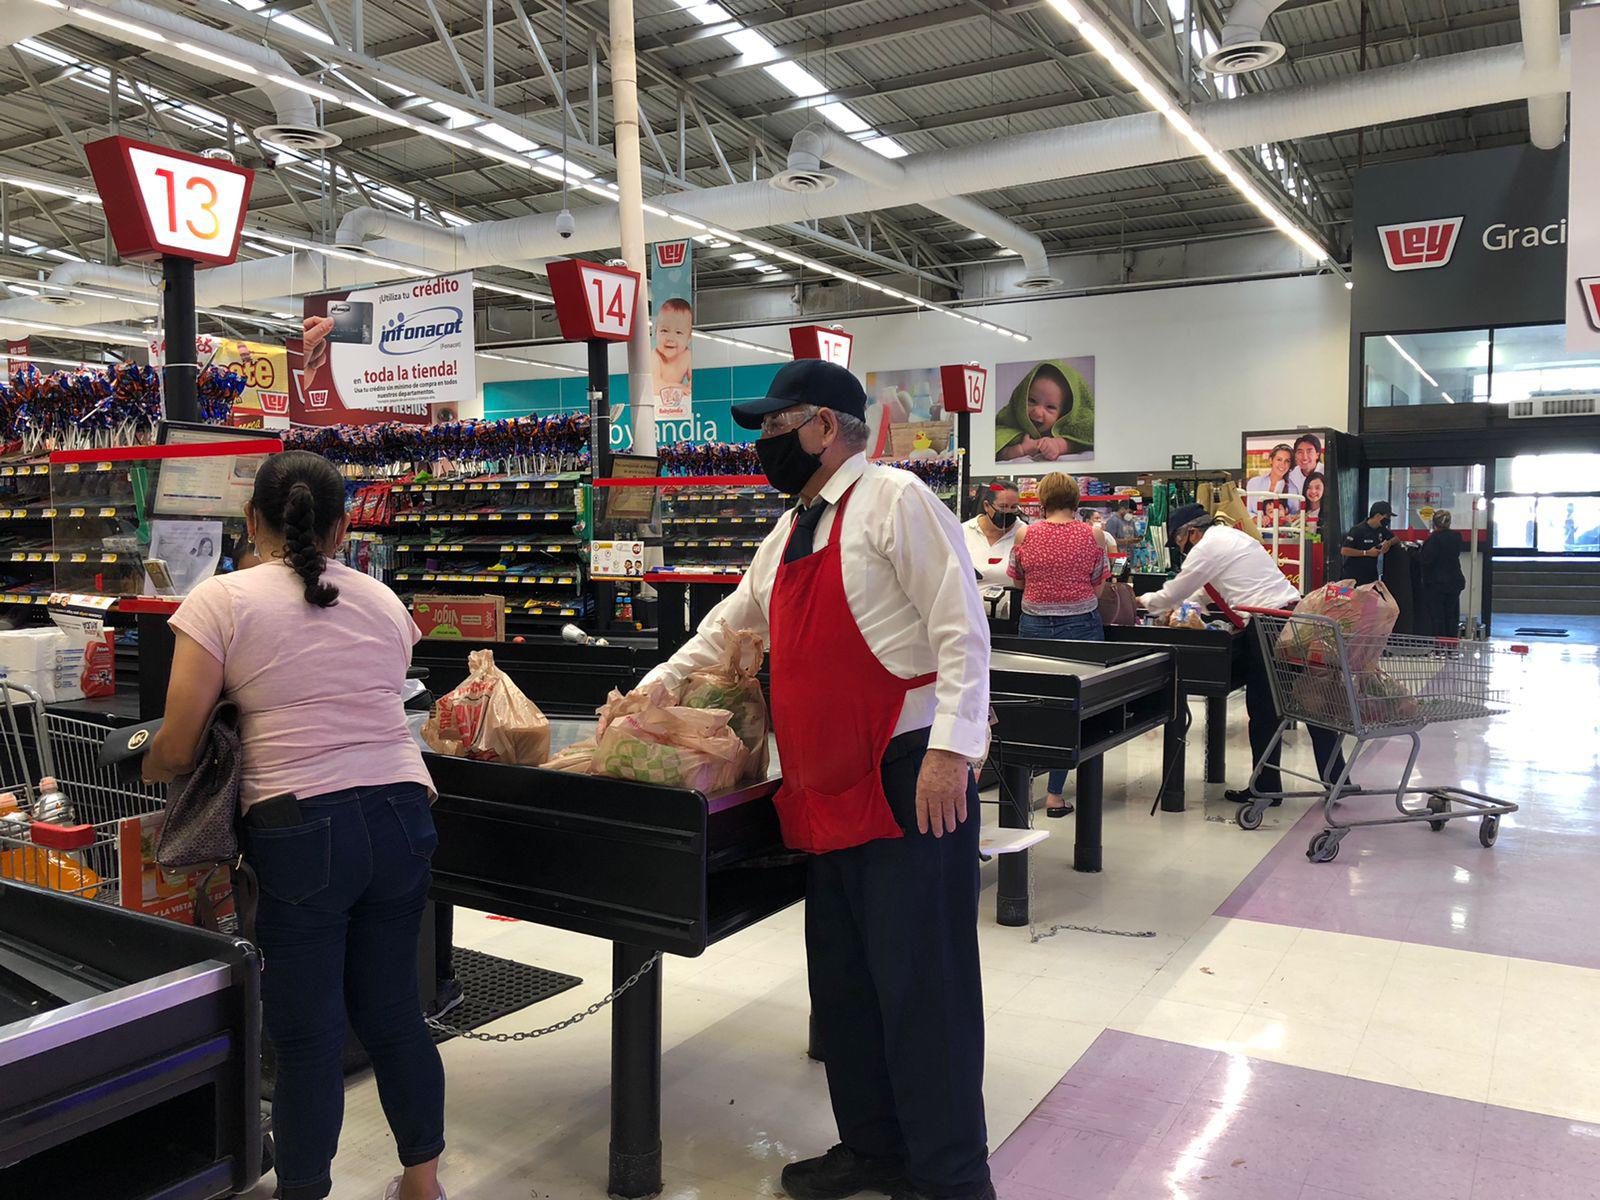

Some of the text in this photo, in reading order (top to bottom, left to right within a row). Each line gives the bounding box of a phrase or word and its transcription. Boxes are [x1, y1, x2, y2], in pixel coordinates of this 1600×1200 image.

[155, 168, 220, 240] 13
[412, 278, 459, 298] crédito
[592, 278, 626, 328] 14
[380, 318, 463, 342] infonacot
[364, 367, 394, 384] toda
[397, 365, 408, 380] la
[412, 360, 457, 379] tienda!
[419, 381, 437, 389] compra
[968, 375, 981, 404] 16
[171, 901, 193, 913] VISTA
